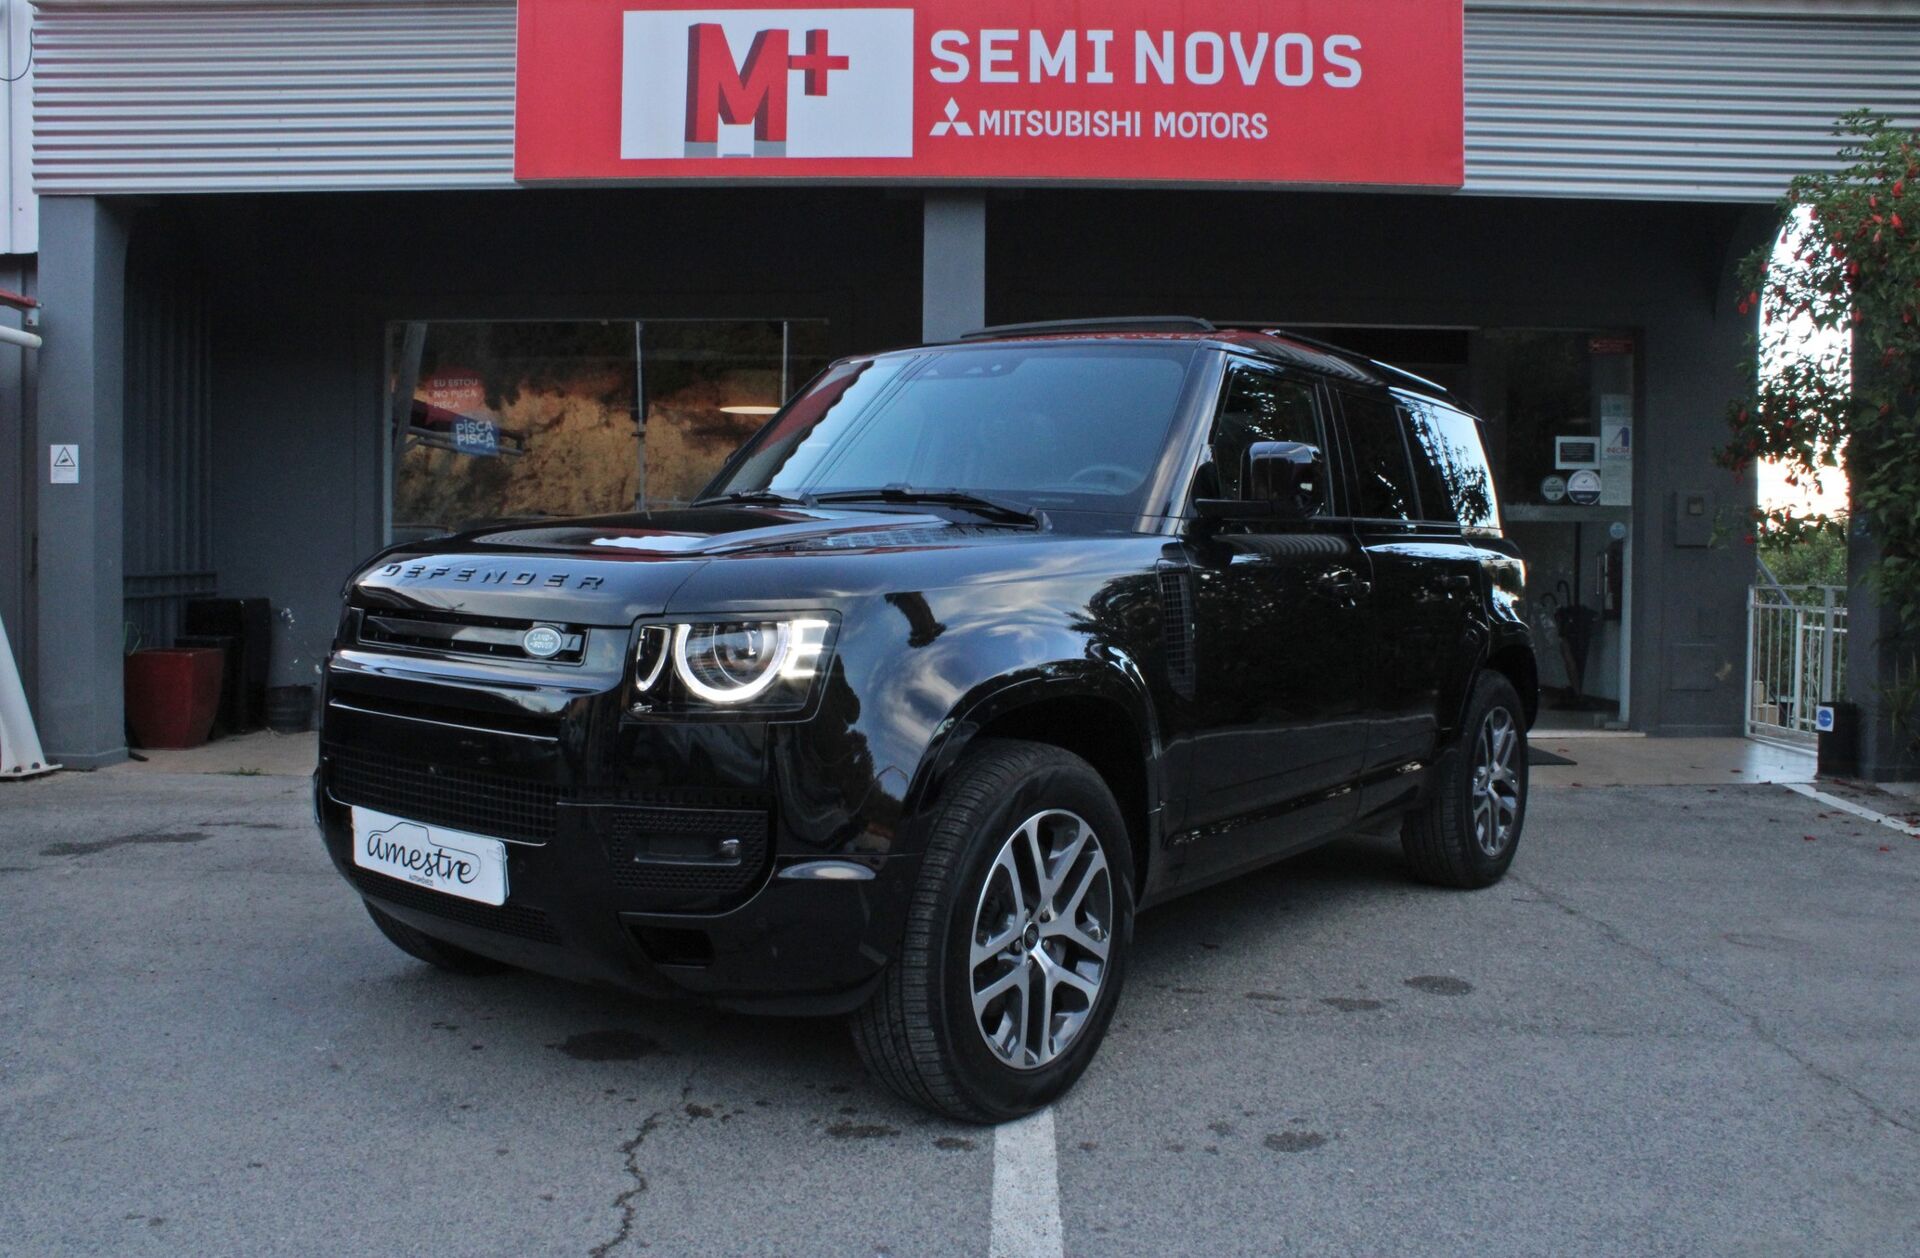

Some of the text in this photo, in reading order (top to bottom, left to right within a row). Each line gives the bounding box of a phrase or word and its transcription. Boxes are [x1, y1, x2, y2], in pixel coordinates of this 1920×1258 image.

[930, 29, 1362, 89] SEMI NOVOS
[979, 109, 1269, 139] MITSUBISHI MOTORS
[433, 390, 477, 398] NO PISCA
[457, 431, 495, 446] PISCA
[381, 564, 604, 590] DEFENDER
[367, 833, 472, 884] amestre
